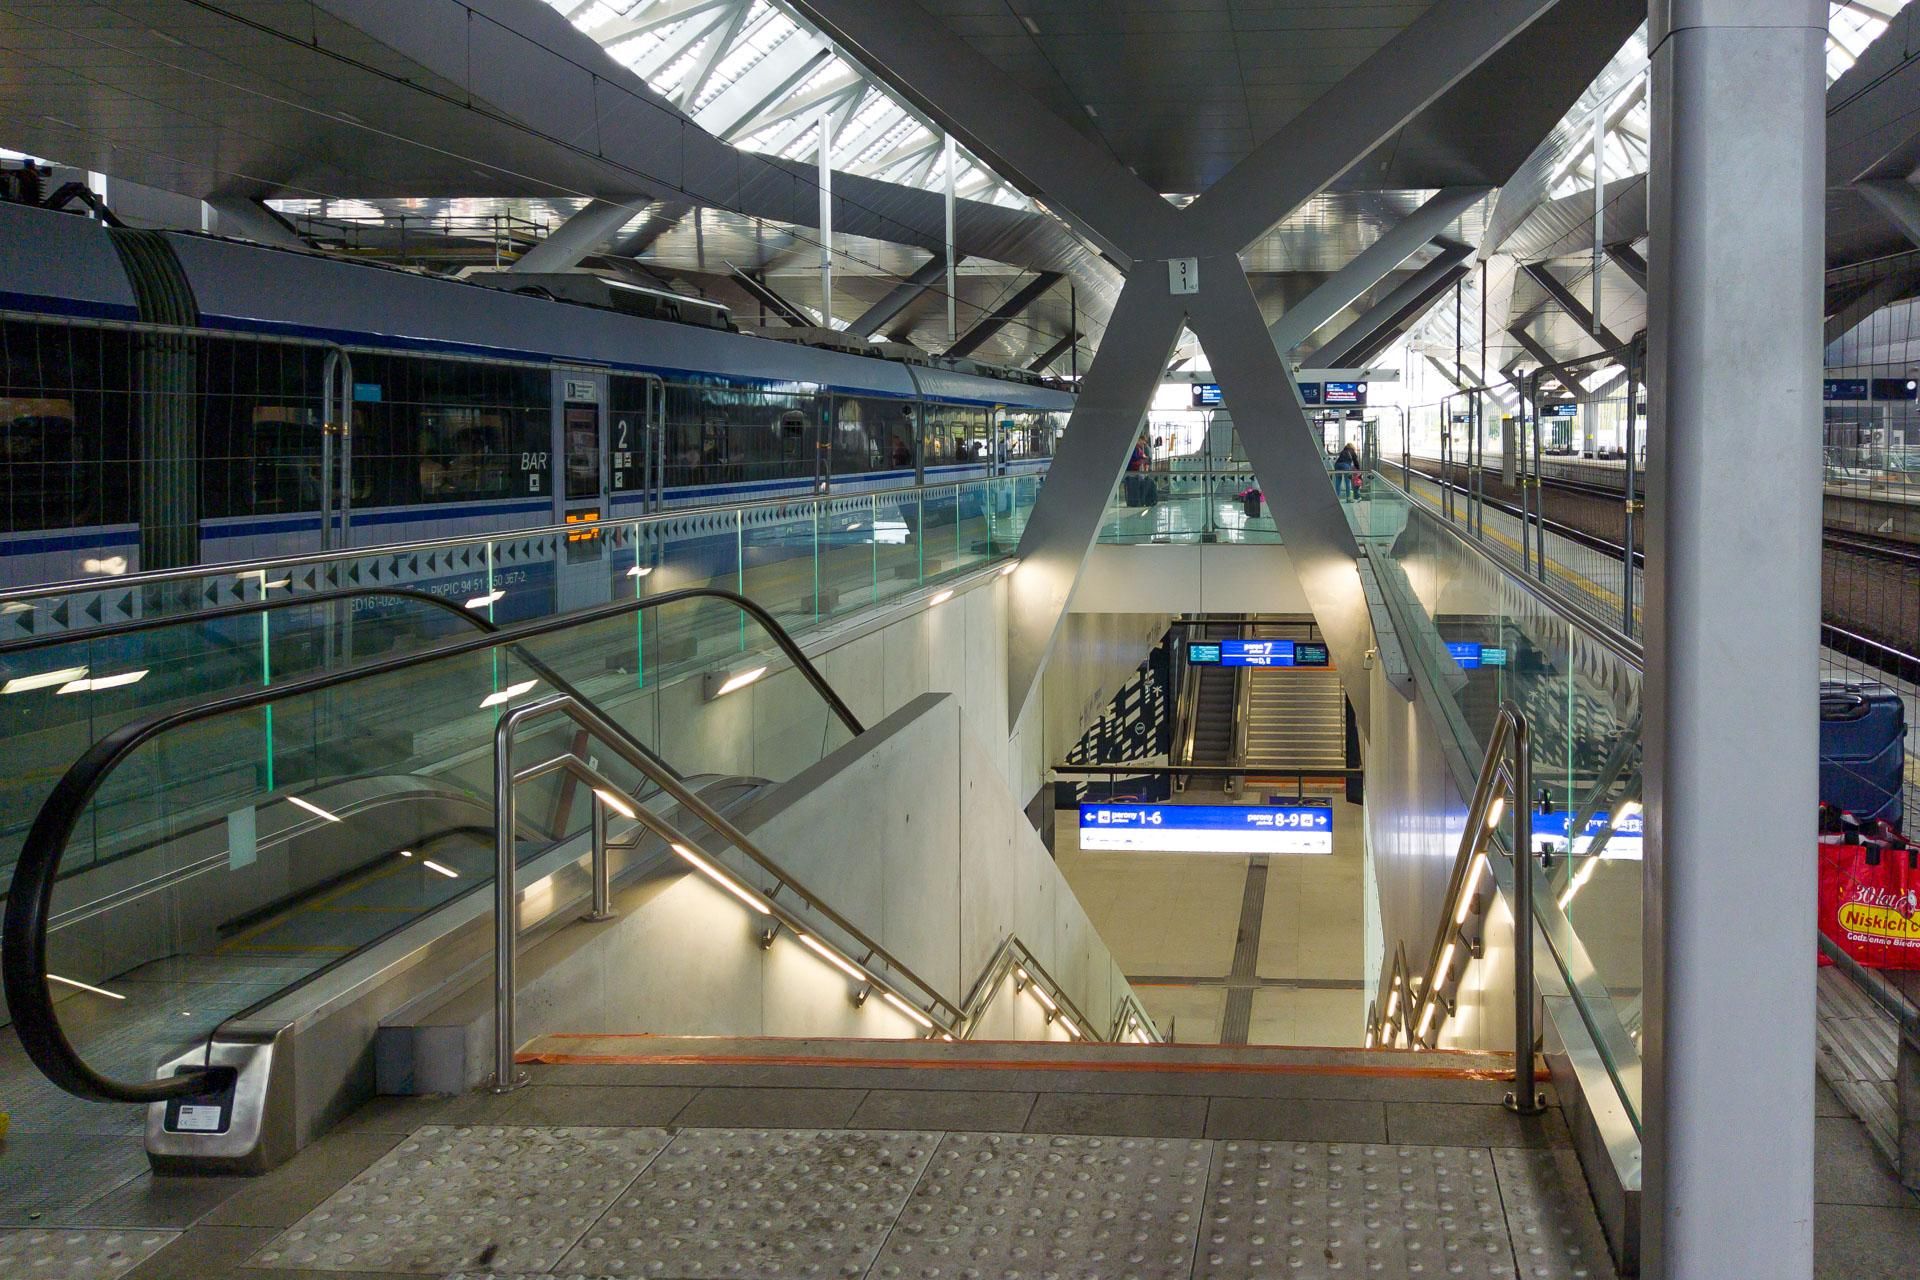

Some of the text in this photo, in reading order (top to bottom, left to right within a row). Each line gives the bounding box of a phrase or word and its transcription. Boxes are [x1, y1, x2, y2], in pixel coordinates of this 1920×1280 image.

[1180, 261, 1187, 275] 3
[1182, 276, 1187, 290] 1
[618, 420, 628, 449] 2
[520, 451, 548, 471] BAR
[1263, 642, 1273, 655] 7
[1138, 811, 1162, 825] 1-6
[1274, 812, 1300, 827] 8-9
[1851, 884, 1876, 904] 30
[1845, 910, 1907, 932] Niskich
